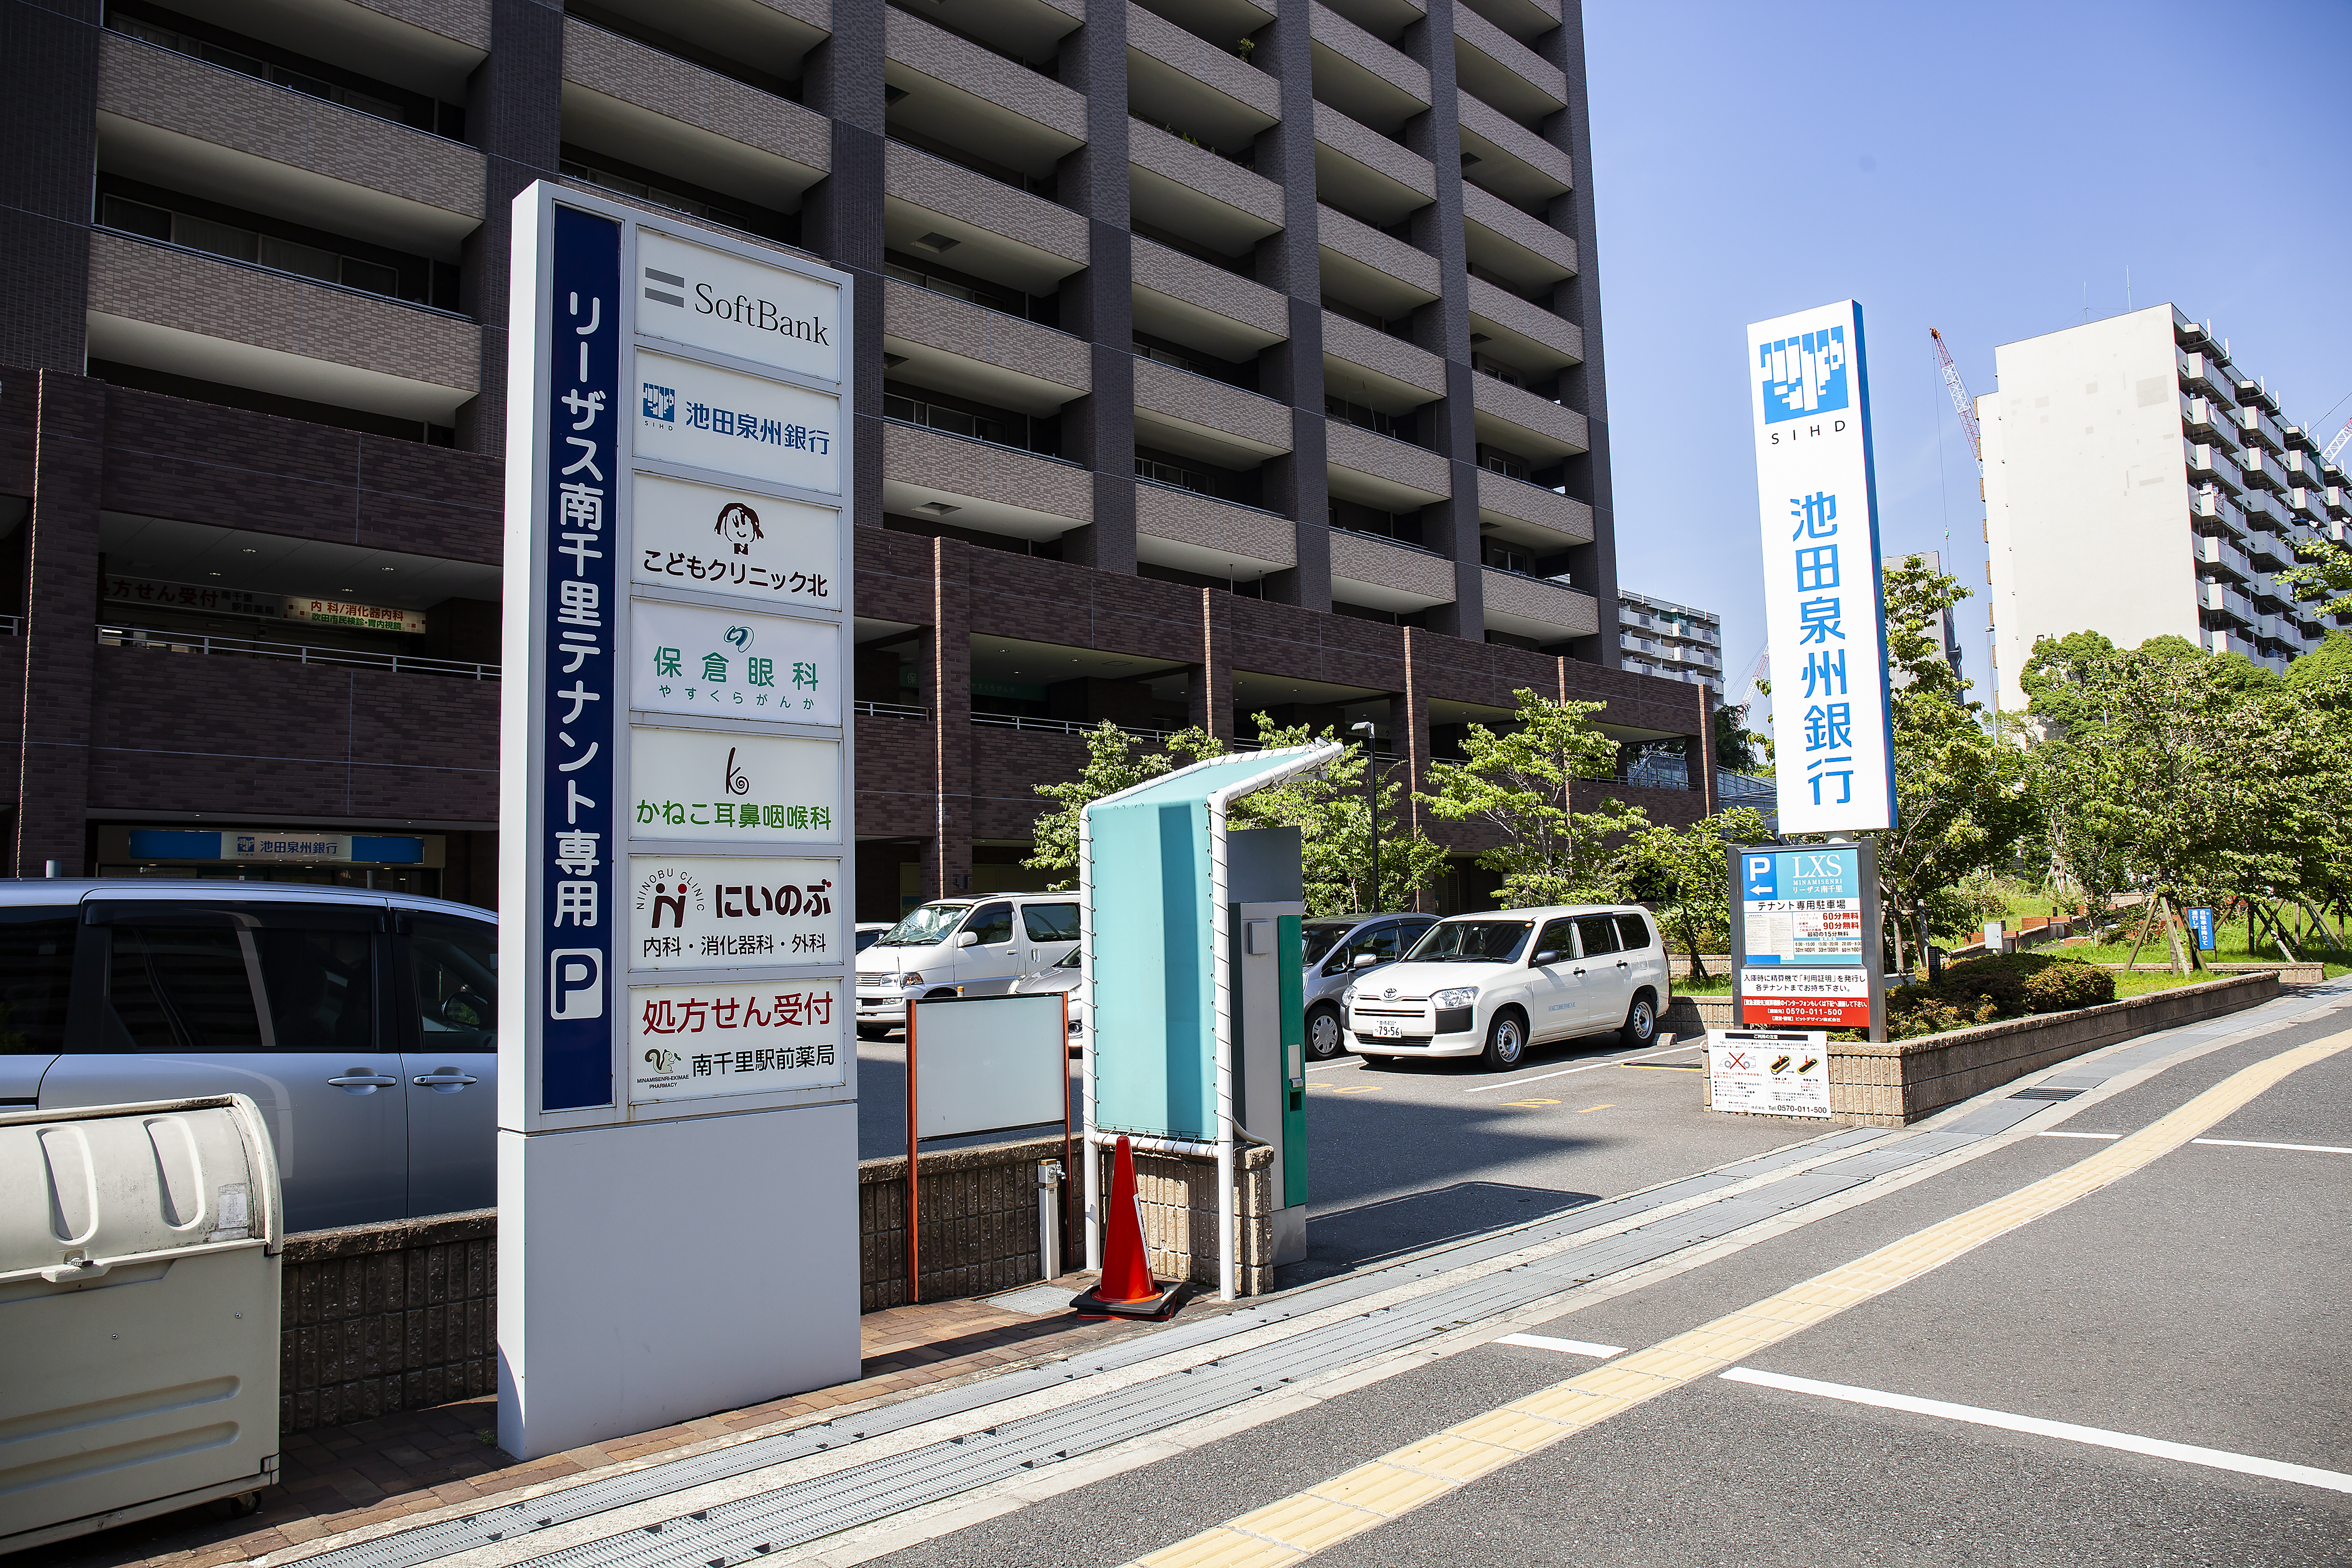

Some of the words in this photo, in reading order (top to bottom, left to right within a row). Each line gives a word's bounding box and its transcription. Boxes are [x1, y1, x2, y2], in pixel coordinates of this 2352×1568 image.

[695, 283, 830, 347] SoftBank
[644, 420, 674, 432] SIHD
[685, 400, 830, 455] 池田泉州銀行
[1771, 420, 1846, 445] SIHD
[644, 550, 828, 597] こどもクリニック北
[221, 591, 253, 603] 南千里
[232, 602, 274, 616] 駅前薬局
[554, 291, 606, 928] リーザス南千里テナント専用
[1789, 491, 1854, 805] 池田泉州銀行
[653, 645, 819, 691] 保倉眼科
[659, 684, 814, 710] やすくらがんか
[636, 799, 832, 830] かねこ耳鼻咽喉科
[260, 841, 338, 854] 池田泉州銀行
[1749, 857, 1771, 881] P
[1792, 854, 1842, 878] LXS
[636, 868, 673, 909] NIINOBU
[680, 871, 705, 911] CLINIC
[715, 879, 832, 918] にいのぶ
[1793, 885, 1843, 894] リーザス南千里
[1758, 900, 1846, 910] テナント専用駐車場
[1823, 921, 1859, 930] 90分無料
[643, 933, 826, 958] 内科・消化器科・外科
[556, 953, 598, 1015] P
[642, 990, 833, 1036] 処方せん受付
[1379, 1026, 1399, 1035] 79-56
[691, 1044, 835, 1077] 南千里駅前薬局
[637, 1074, 689, 1083] MINAMISENRI-EKIMAE
